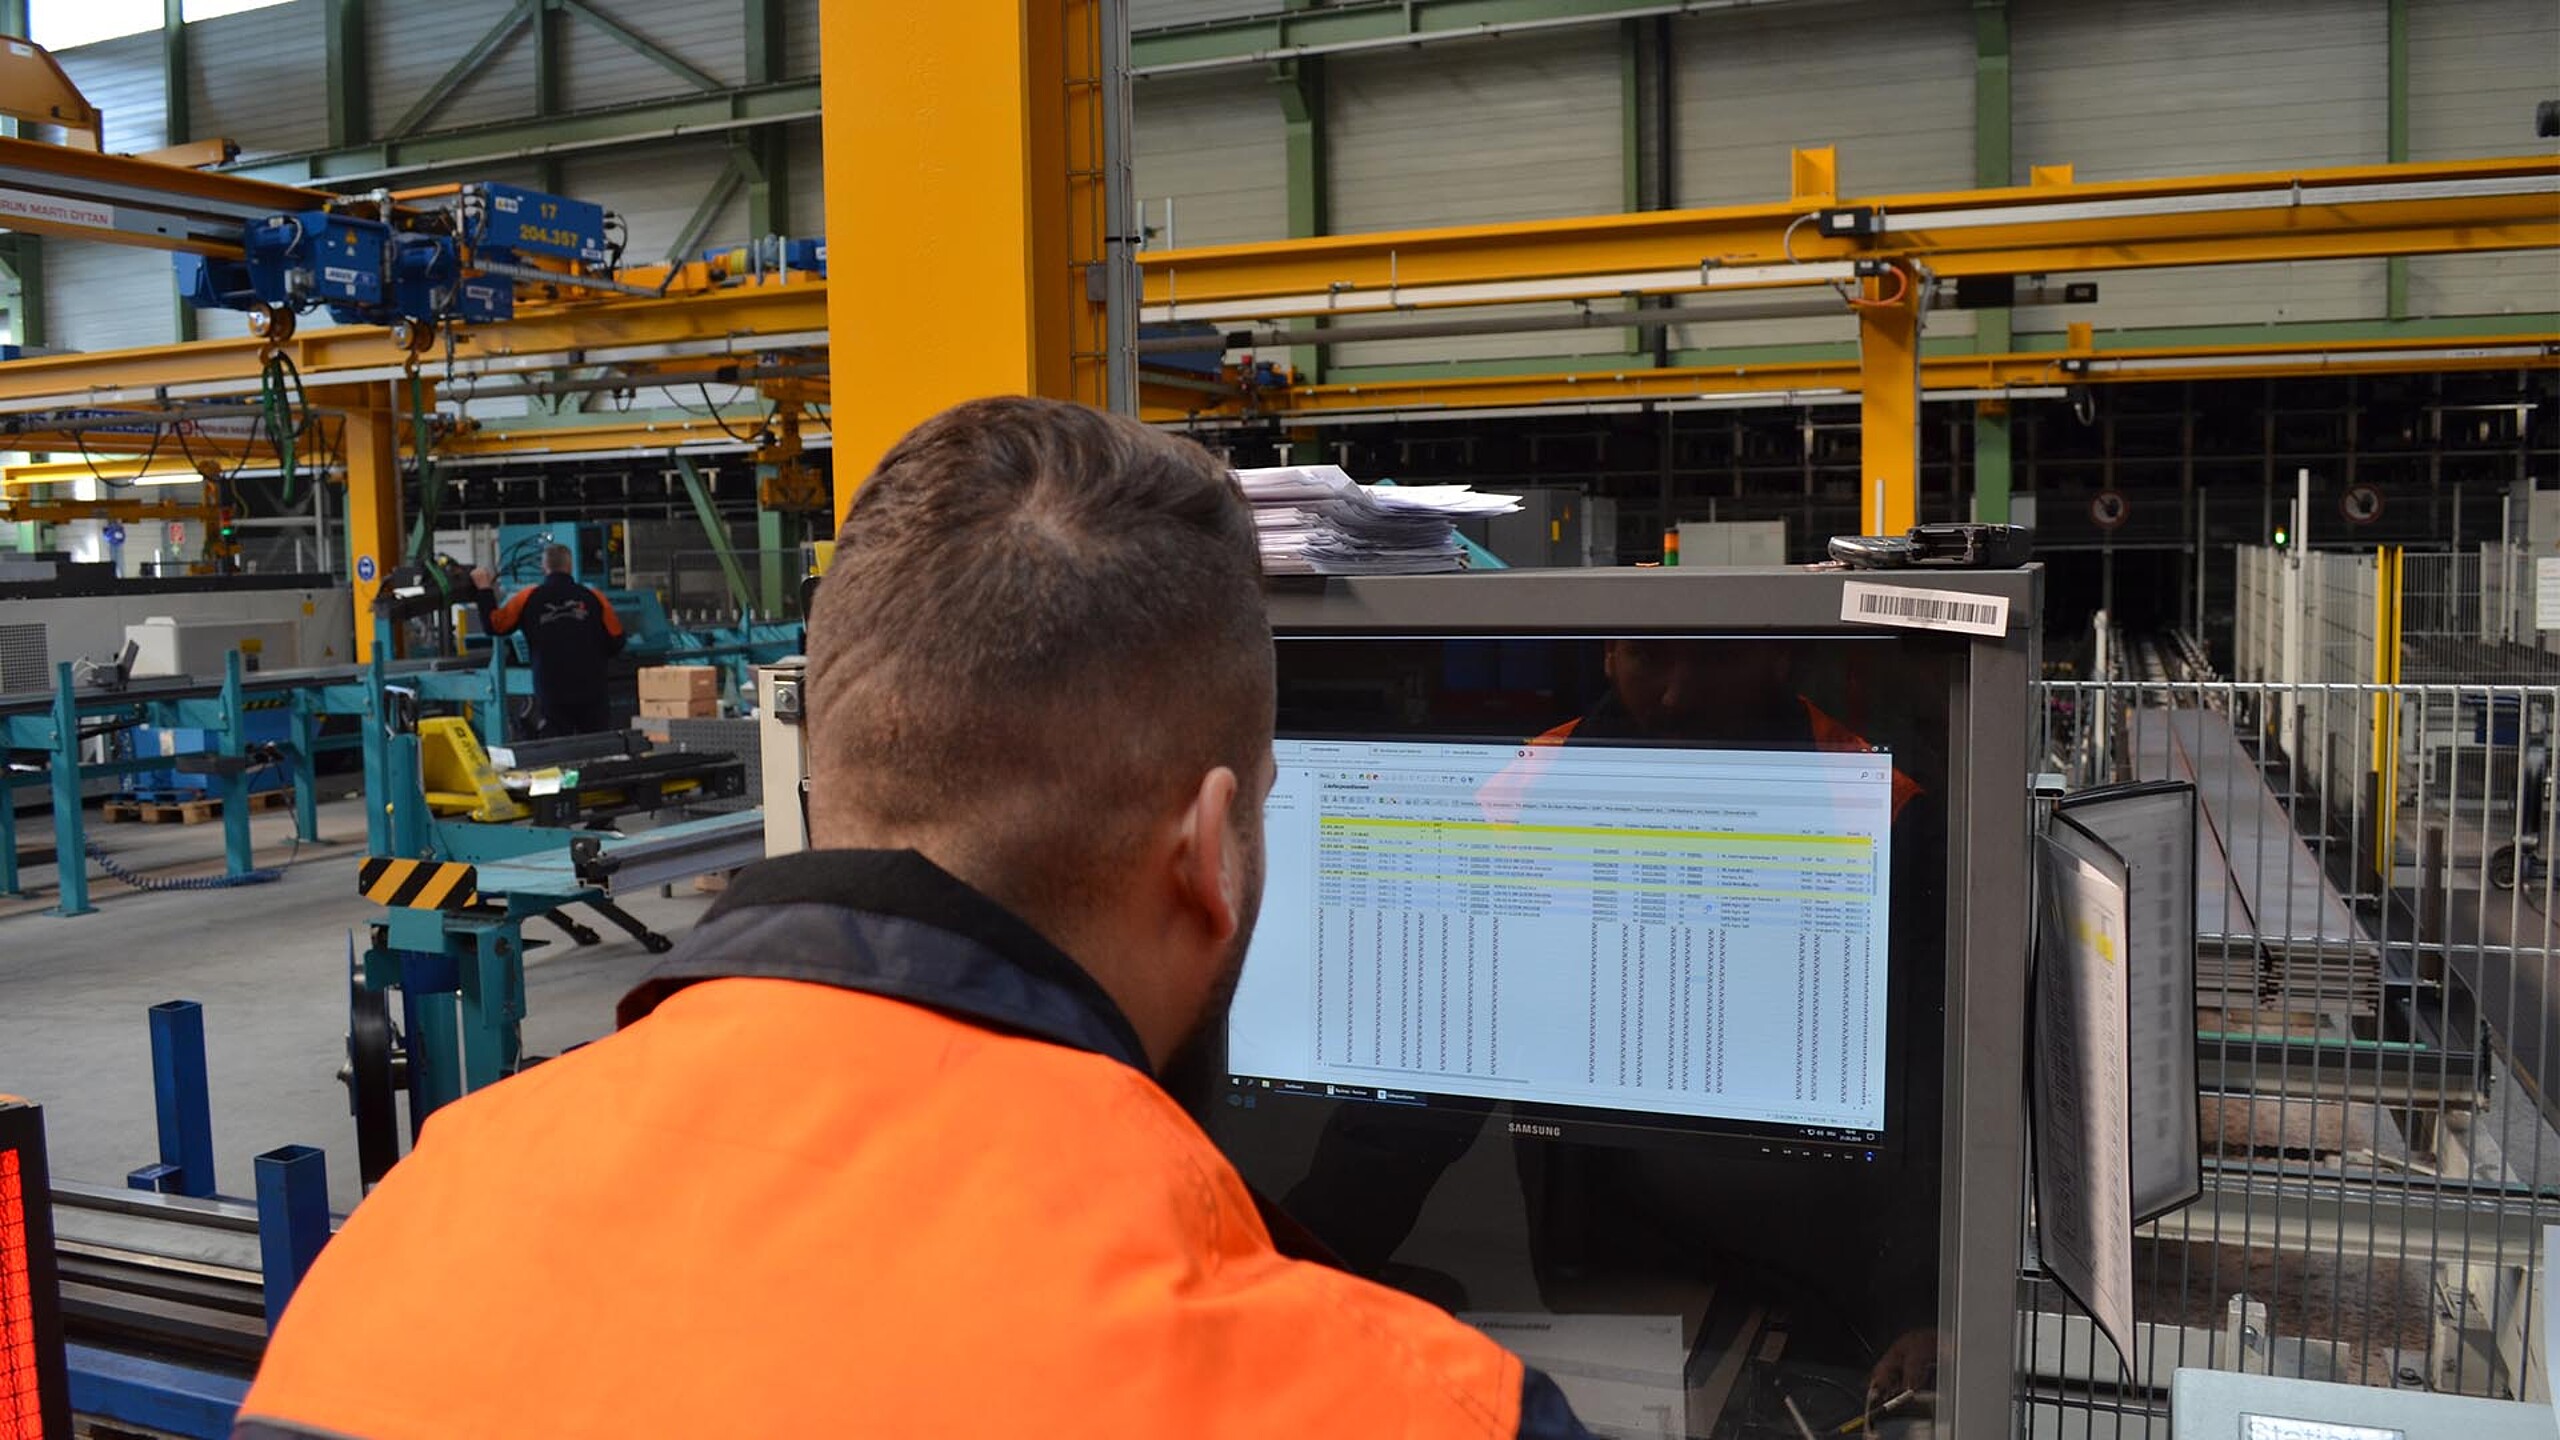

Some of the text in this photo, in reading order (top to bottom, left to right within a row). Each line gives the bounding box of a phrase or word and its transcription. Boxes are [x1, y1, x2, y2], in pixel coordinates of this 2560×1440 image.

[540, 202, 558, 220] 17
[519, 223, 578, 249] 204.357
[1507, 1122, 1561, 1137] SAMSUNG
[2249, 1421, 2363, 1440] Stati
